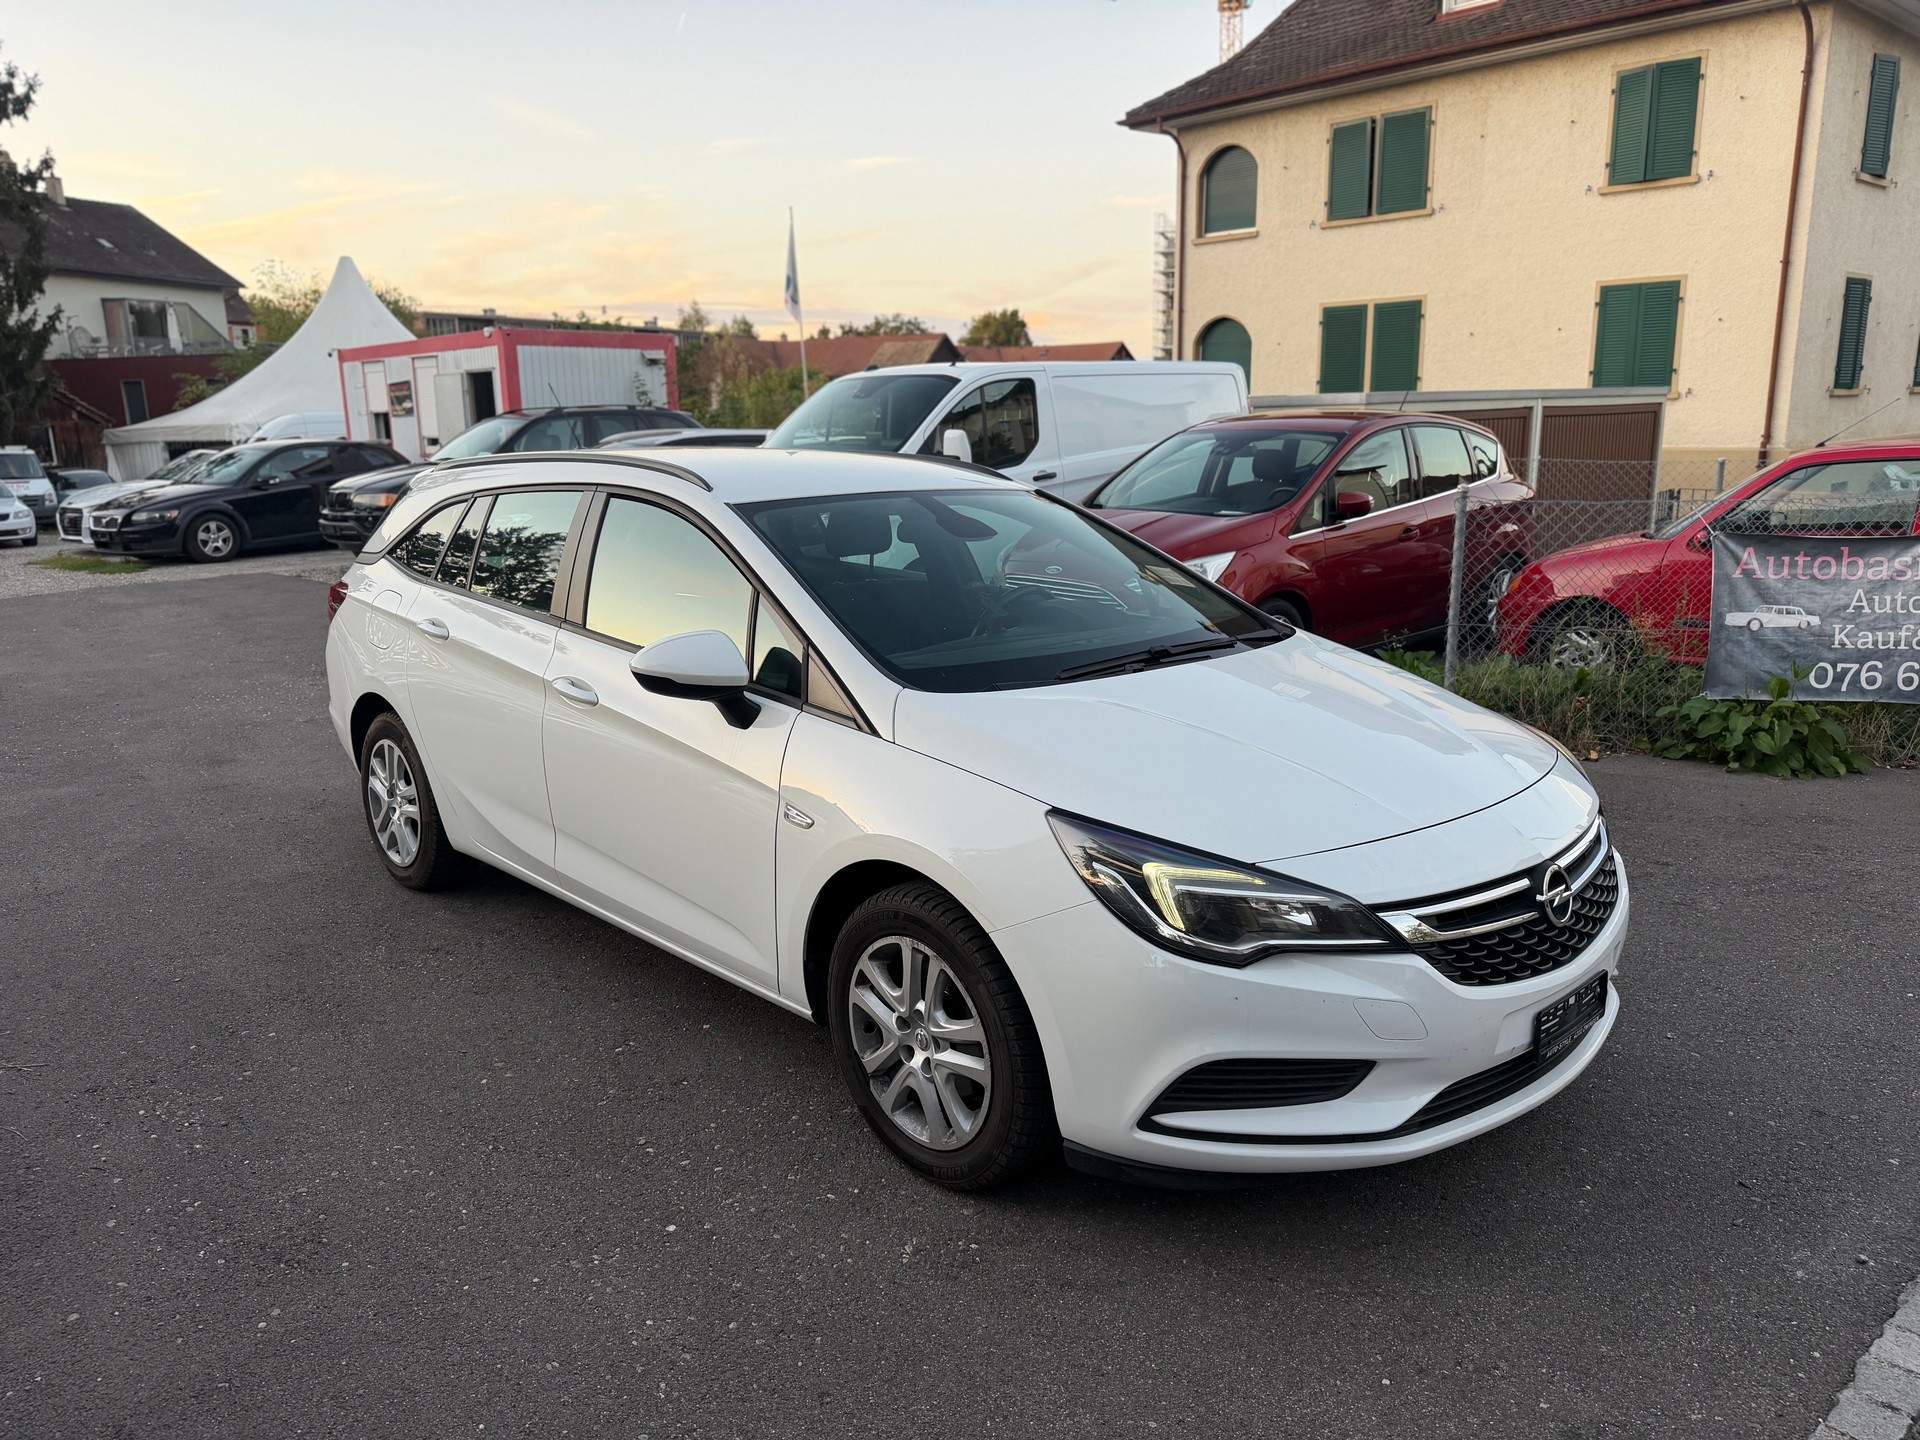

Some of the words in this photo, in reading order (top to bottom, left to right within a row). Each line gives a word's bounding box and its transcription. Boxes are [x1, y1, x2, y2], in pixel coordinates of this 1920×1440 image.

[1808, 660, 1883, 692] 076
[1897, 661, 1920, 691] 6
[1545, 1035, 1572, 1058] AUTO-STYLE
[933, 1164, 969, 1179] KENDA
